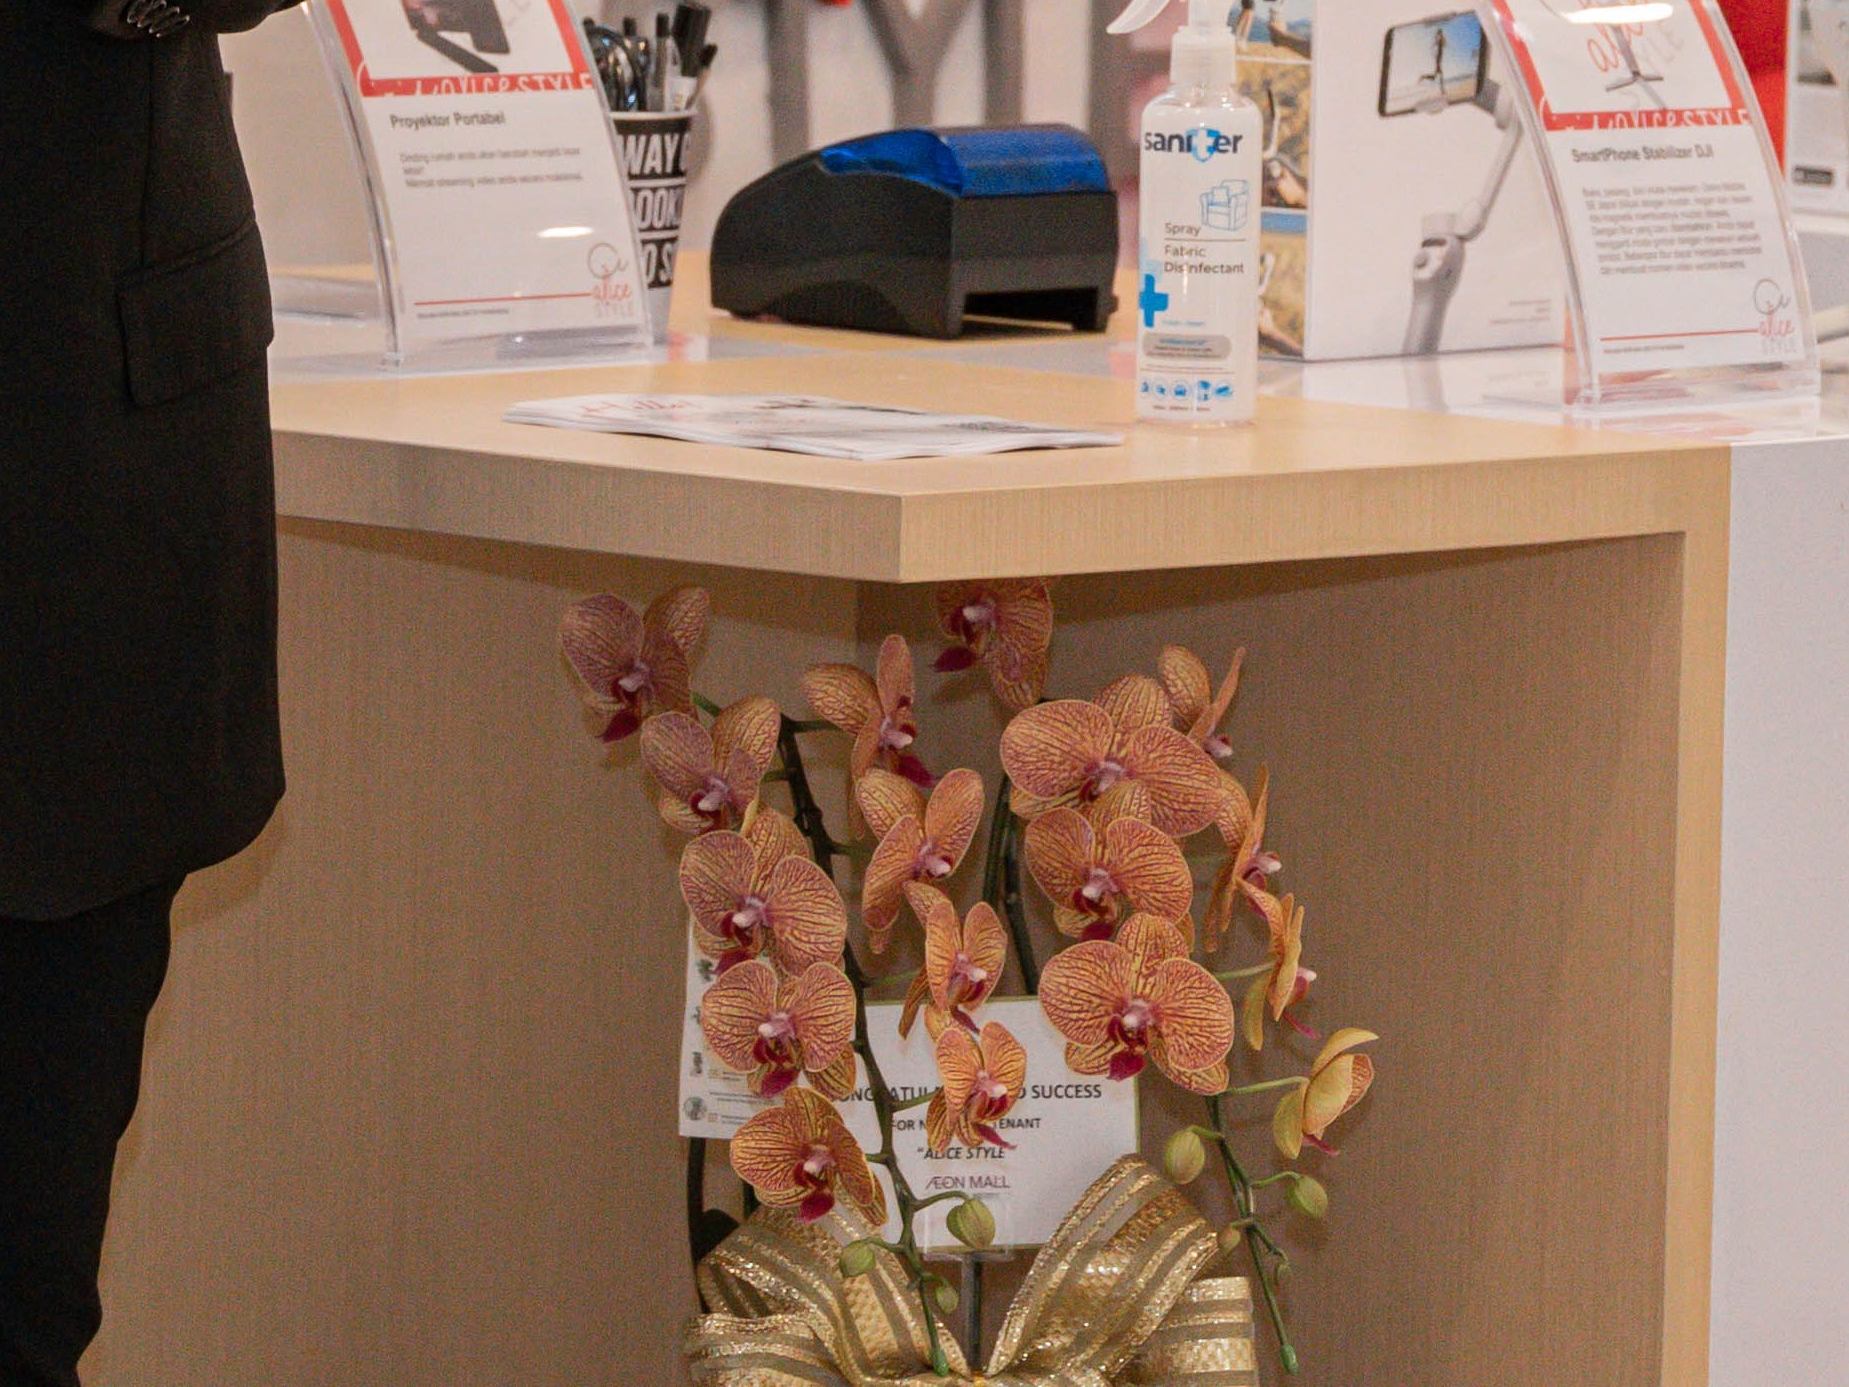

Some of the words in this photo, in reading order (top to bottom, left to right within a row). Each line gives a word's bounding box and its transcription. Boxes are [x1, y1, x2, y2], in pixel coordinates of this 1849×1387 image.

[389, 113, 451, 131] Proyektor
[454, 110, 507, 127] Portabel
[1571, 145, 1641, 163] SmartPhone
[1642, 144, 1693, 160] Stabilizer
[1164, 222, 1202, 237] Spray
[1164, 244, 1207, 258] Fabric
[1164, 261, 1245, 275] Disinfectant
[1032, 1084, 1102, 1101] SUCCESS
[969, 1175, 1011, 1189] MALL
